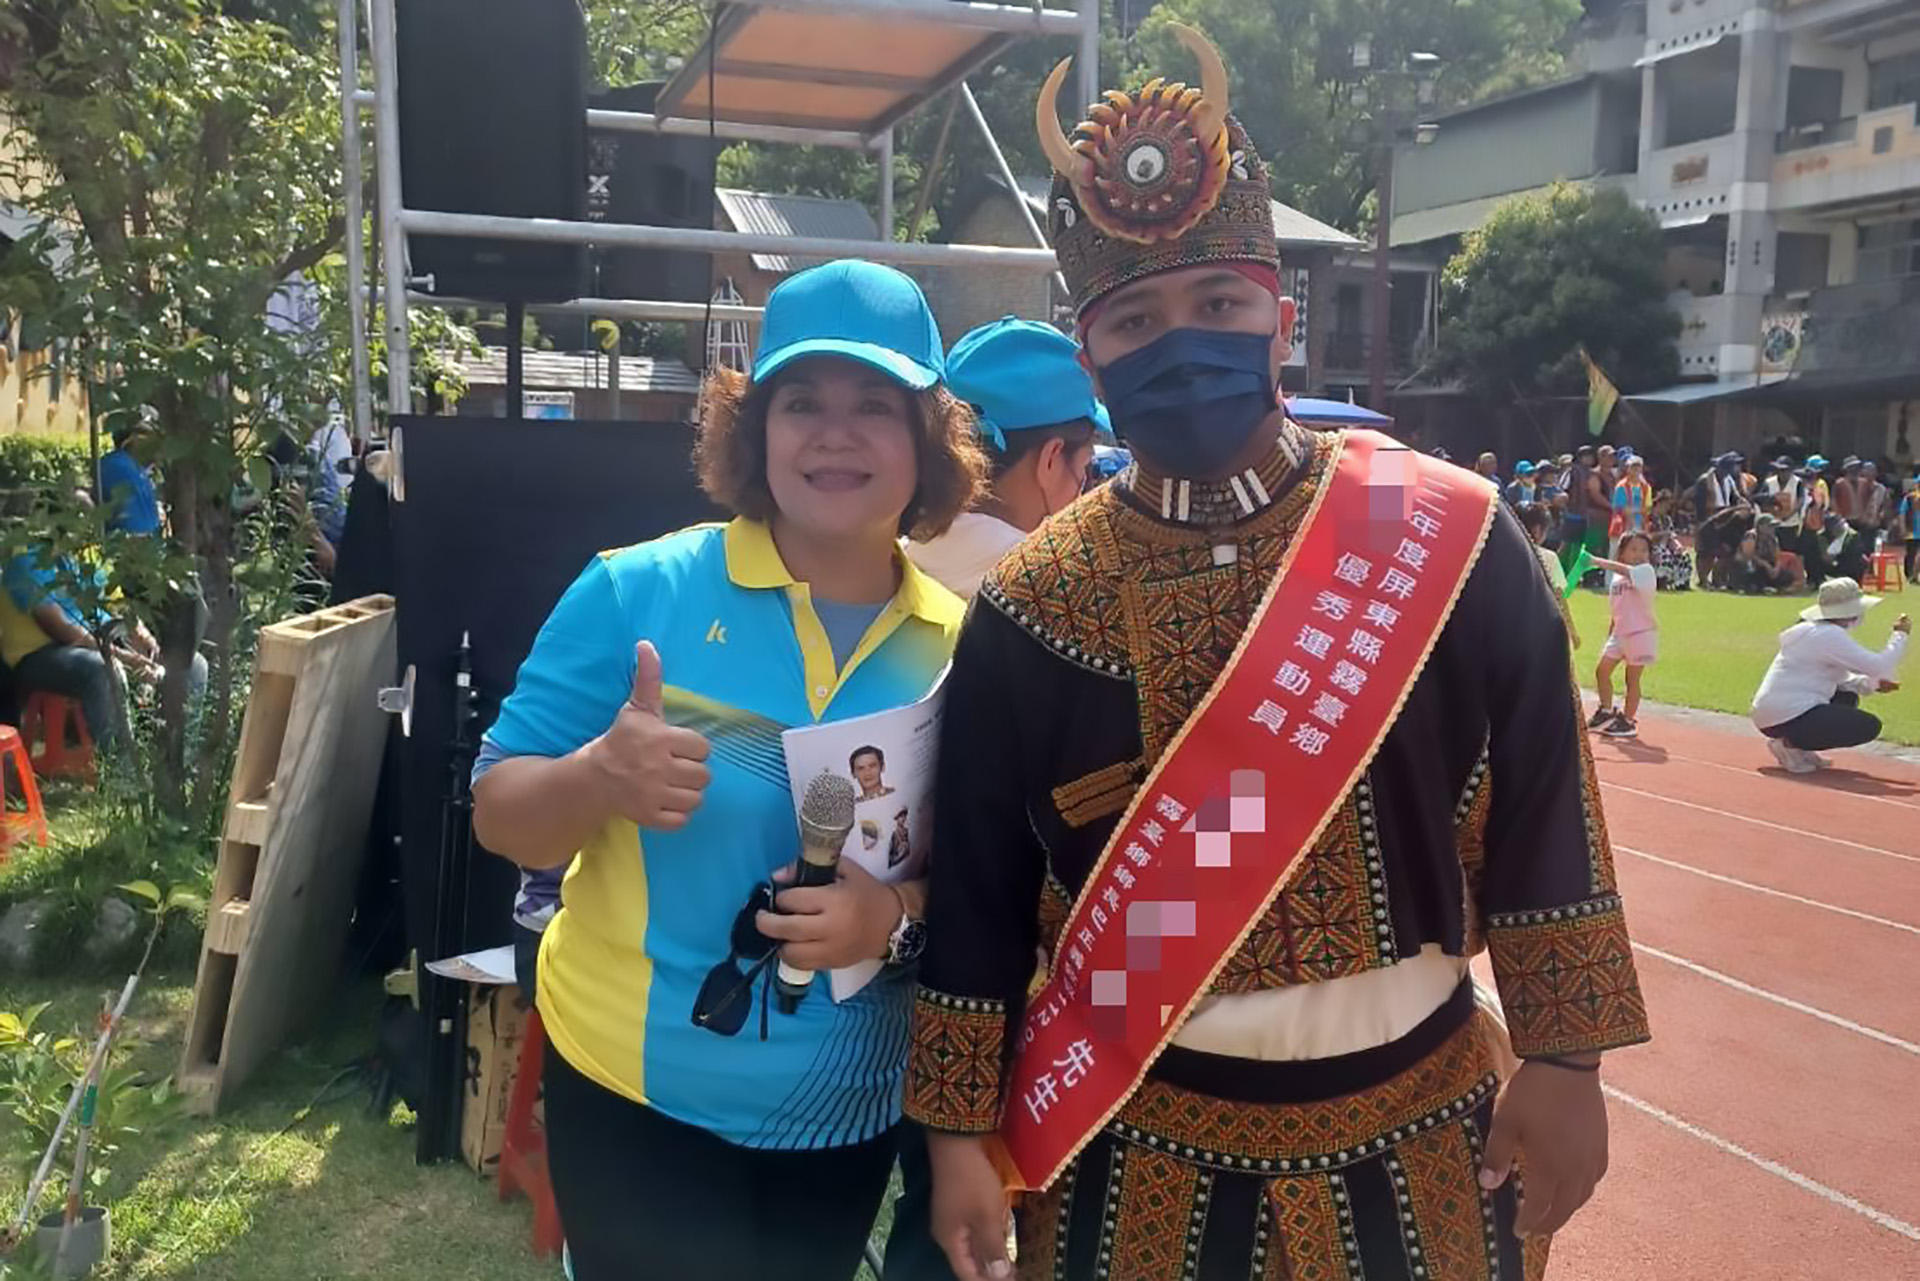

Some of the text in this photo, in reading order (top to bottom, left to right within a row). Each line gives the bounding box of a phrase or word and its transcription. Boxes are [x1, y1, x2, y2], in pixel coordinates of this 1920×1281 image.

[1248, 551, 1373, 736] 優秀運動員
[1024, 1037, 1096, 1125] 先生
